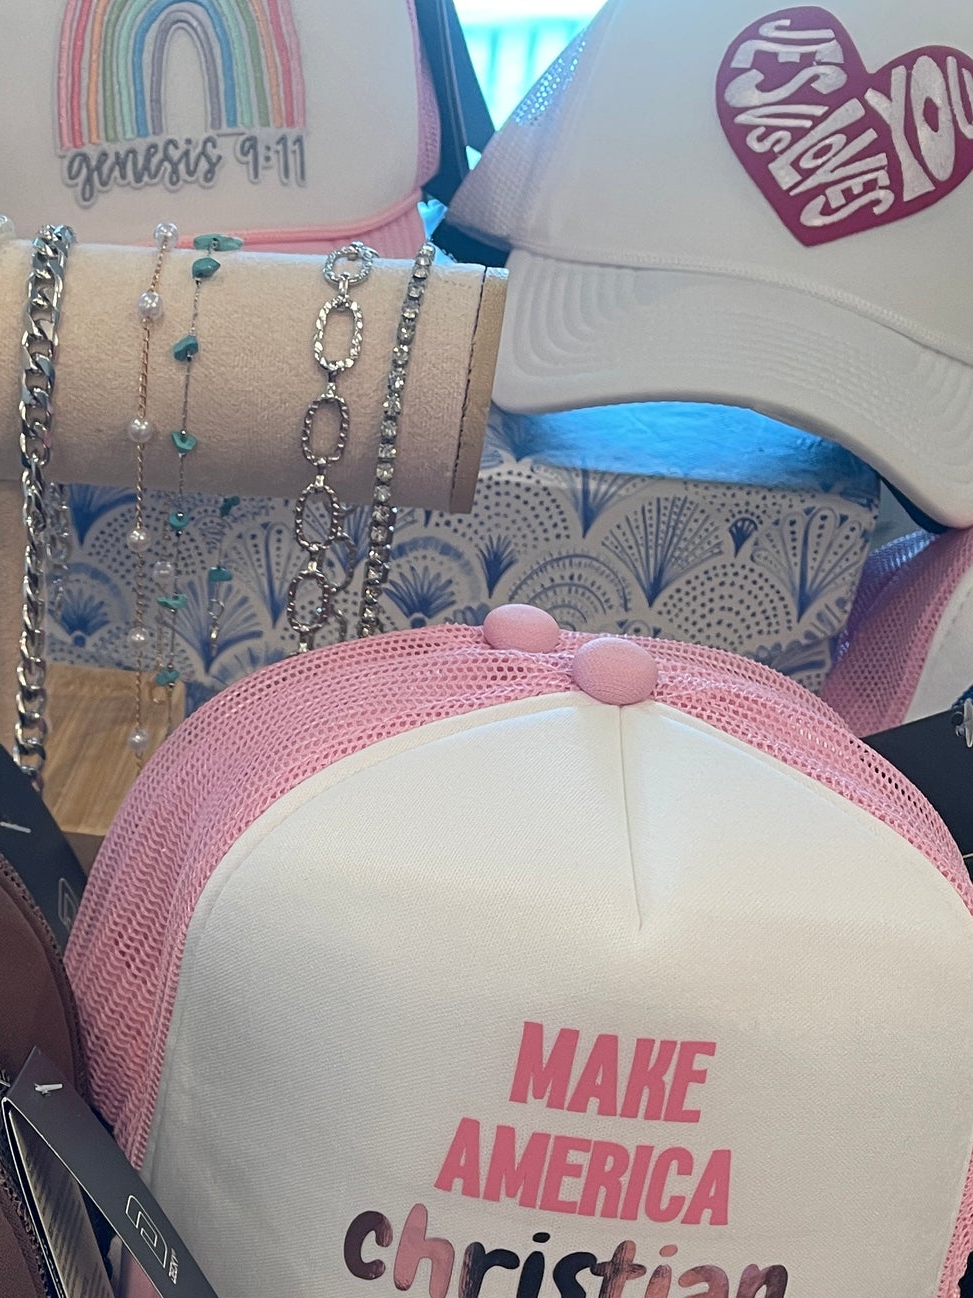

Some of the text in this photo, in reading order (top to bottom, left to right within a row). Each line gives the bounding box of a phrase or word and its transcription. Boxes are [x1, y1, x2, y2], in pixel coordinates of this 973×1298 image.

[724, 19, 848, 154] JESUS
[66, 133, 308, 203] genesis 9:11
[767, 97, 895, 228] LOVES
[509, 1021, 717, 1124] MAKE
[433, 1116, 732, 1226] AMERICA
